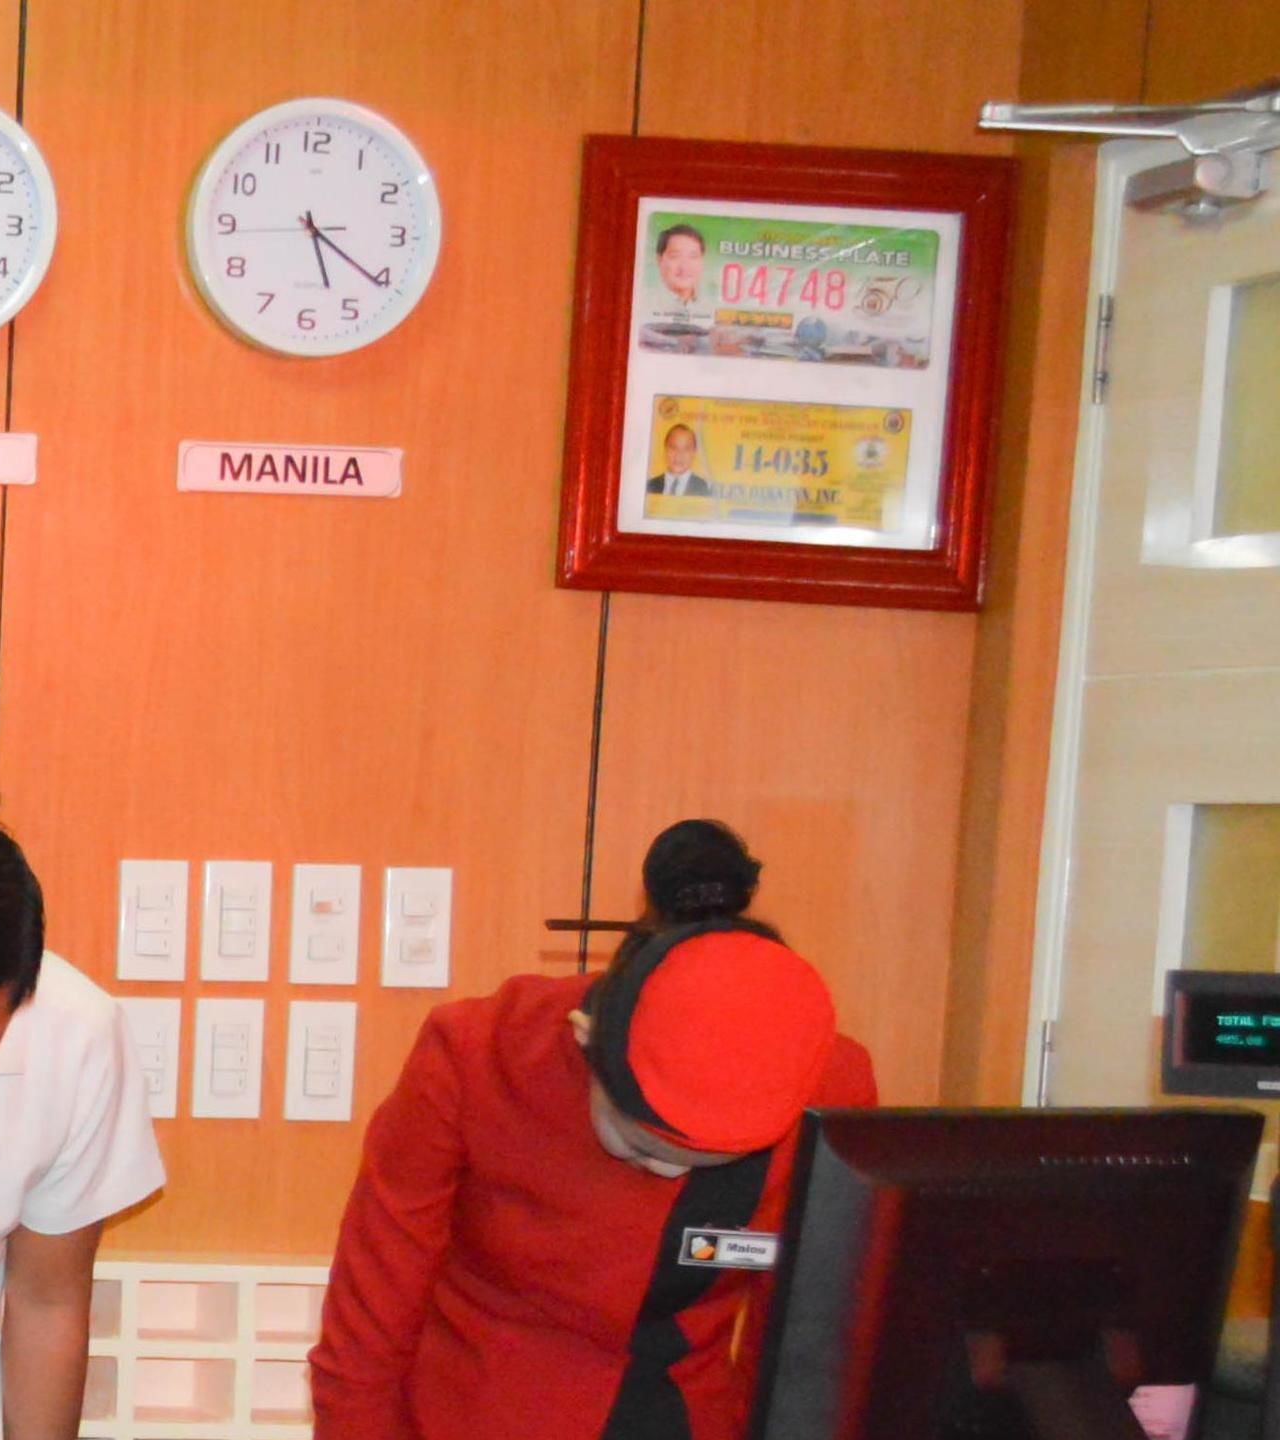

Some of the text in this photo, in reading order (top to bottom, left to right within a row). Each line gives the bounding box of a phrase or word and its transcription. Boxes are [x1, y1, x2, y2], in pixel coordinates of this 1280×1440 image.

[303, 131, 331, 153] 12
[264, 143, 280, 164] 11
[358, 150, 364, 170] 1
[232, 173, 256, 196] 10
[380, 182, 399, 204] 2
[6, 215, 23, 236] 3
[218, 214, 236, 235] 9
[389, 226, 406, 247] 3
[719, 240, 912, 267] BUSINESS PLATE
[226, 257, 246, 278] 8
[374, 267, 391, 288] 4
[721, 262, 847, 311] 04748
[256, 293, 275, 314] 7
[341, 299, 360, 320] 5
[297, 309, 316, 330] 6
[219, 452, 364, 486] MANILA
[733, 443, 830, 477] 14-035
[1216, 1015, 1254, 1026] TOTAL
